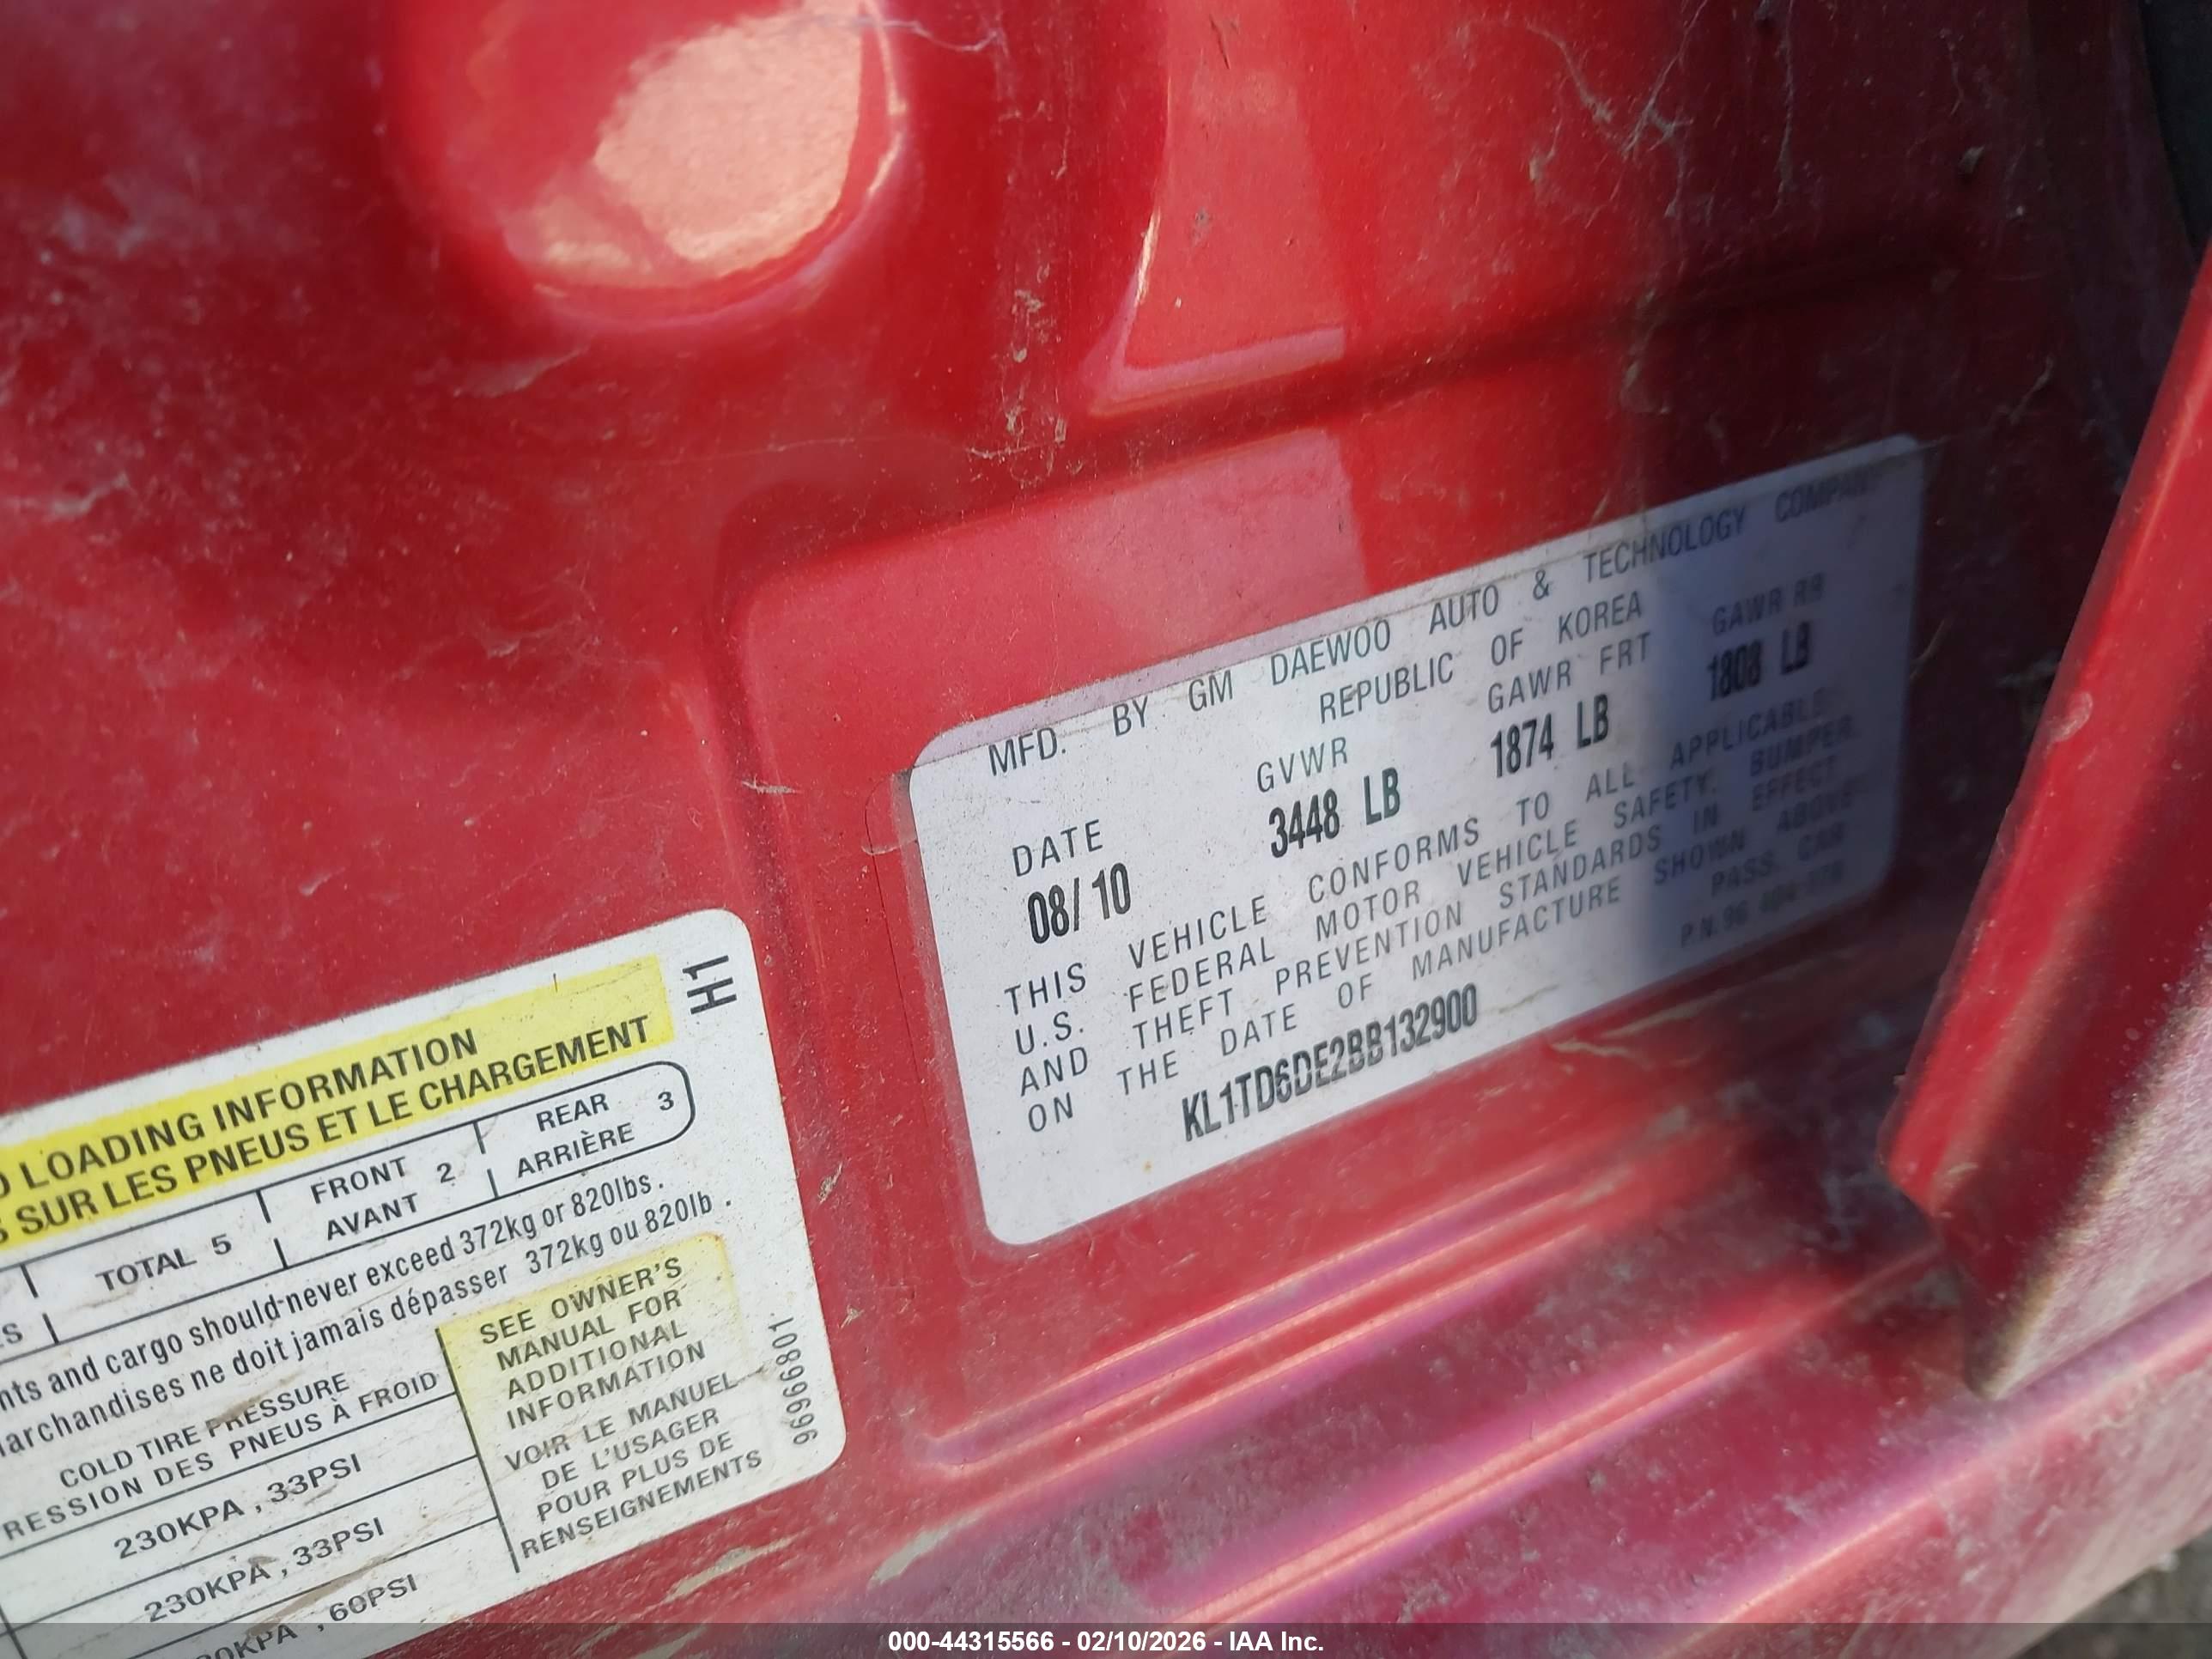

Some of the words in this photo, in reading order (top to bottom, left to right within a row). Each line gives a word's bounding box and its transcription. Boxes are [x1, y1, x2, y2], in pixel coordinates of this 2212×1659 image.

[988, 726, 1066, 776] MFD.
[1113, 696, 1149, 737] BY
[1188, 670, 1235, 712] GM
[1270, 619, 1391, 686] DAEWOO
[1429, 583, 1499, 635] AUTO
[1532, 568, 1550, 601] &
[1583, 505, 1746, 585] TECHNOLOGY
[1711, 585, 1786, 636] GAWR
[1320, 652, 1453, 724] REPUBLIC
[1490, 629, 1523, 667] OF
[1557, 589, 1643, 645] KOREA
[1488, 659, 1572, 714] GAWR
[1599, 631, 1651, 676] FRT
[1706, 639, 1764, 702] 1808
[1781, 619, 1811, 675] LB
[1257, 736, 1349, 793] GVWR
[1491, 713, 1554, 778] 1874
[1577, 694, 1609, 750] LB
[1005, 962, 1087, 1016] THIS
[1128, 895, 1267, 970] VEHICLE
[1308, 817, 1480, 904] CONFORMS
[1516, 791, 1550, 827] TO
[1586, 761, 1636, 803] ALL
[1669, 686, 1826, 771] APPLICABLE
[1012, 818, 1103, 878] DATE
[1268, 788, 1340, 858] 3448
[1364, 767, 1401, 826] LB
[1014, 1011, 1085, 1056] U.S.
[1127, 936, 1276, 1012] FEDERAL
[1315, 878, 1421, 942] MOTOR
[1457, 818, 1578, 888] VEHICLE
[1019, 1046, 1089, 1097] AND
[1132, 988, 1235, 1050] THEFT
[1274, 900, 1462, 996] PREVENTION
[1498, 825, 1662, 910] STANDARDS
[1692, 803, 1719, 836] IN
[1751, 754, 1838, 812] EFFECT
[682, 954, 738, 1015] H1
[1028, 1092, 1074, 1133] ON
[1116, 1050, 1178, 1097] THE
[1220, 1004, 1297, 1057] DATE
[1337, 973, 1373, 1010] OF
[1411, 876, 1621, 981] MANUFACTURE
[1653, 826, 1747, 887] SHOWN
[1181, 981, 1478, 1143] KL1TD6DE2BB132900
[15, 1188, 100, 1234] SUR
[103, 1163, 178, 1211] LES
[185, 1123, 310, 1184] PNEUS
[320, 1105, 357, 1140] ET
[368, 1090, 413, 1127] LE
[418, 1014, 648, 1111] CHARGEMENT
[19, 1112, 205, 1189] LOADING
[212, 1028, 479, 1132] INFORMATION
[516, 1121, 635, 1178] ARRIÈRE
[536, 1093, 610, 1132] REAR
[658, 1091, 674, 1112] 3
[310, 1157, 407, 1204] FRONT
[436, 1162, 455, 1183] 2
[325, 1192, 418, 1241] AVANT
[47, 1355, 100, 1394] and
[105, 1333, 183, 1365] cargo
[285, 1271, 357, 1314] never
[367, 1235, 455, 1286] exceed
[459, 1212, 538, 1255] 372kg
[542, 1201, 565, 1228] or
[94, 1248, 198, 1291] TOTAL
[212, 1233, 232, 1255] 5
[479, 1309, 537, 1345] SEE
[550, 1255, 684, 1321] OWNER'S
[0, 1376, 185, 1458] archandises
[191, 1364, 226, 1391] ne
[232, 1337, 289, 1376] doit
[290, 1307, 385, 1362] jamais
[391, 1262, 508, 1322] dépasser
[526, 1228, 605, 1274] 372kg
[611, 1219, 640, 1242] ou
[495, 1316, 617, 1371] MANUAL
[626, 1289, 684, 1325] FOR
[506, 1318, 689, 1401] ADDITIONAL
[503, 1433, 572, 1472] VOIR
[583, 1416, 617, 1444] LE
[627, 1370, 739, 1427] MANUEL
[506, 1340, 707, 1431] INFORMATION
[768, 1315, 819, 1446] 96966801
[3, 1477, 143, 1540] RESSION
[155, 1451, 214, 1488] DES
[228, 1414, 323, 1462] PNEUS
[332, 1397, 352, 1424] À
[357, 1371, 439, 1413] FROID
[59, 1449, 133, 1488] COLD
[137, 1426, 200, 1462] TIRE
[204, 1371, 350, 1437] PRESSURE
[541, 1462, 580, 1491] DE
[592, 1407, 721, 1472] L'USAGER
[519, 1448, 763, 1559] RENSEIGNEMENTS
[536, 1480, 611, 1522] POUR
[622, 1449, 691, 1488] PLUS
[700, 1430, 734, 1460] DE
